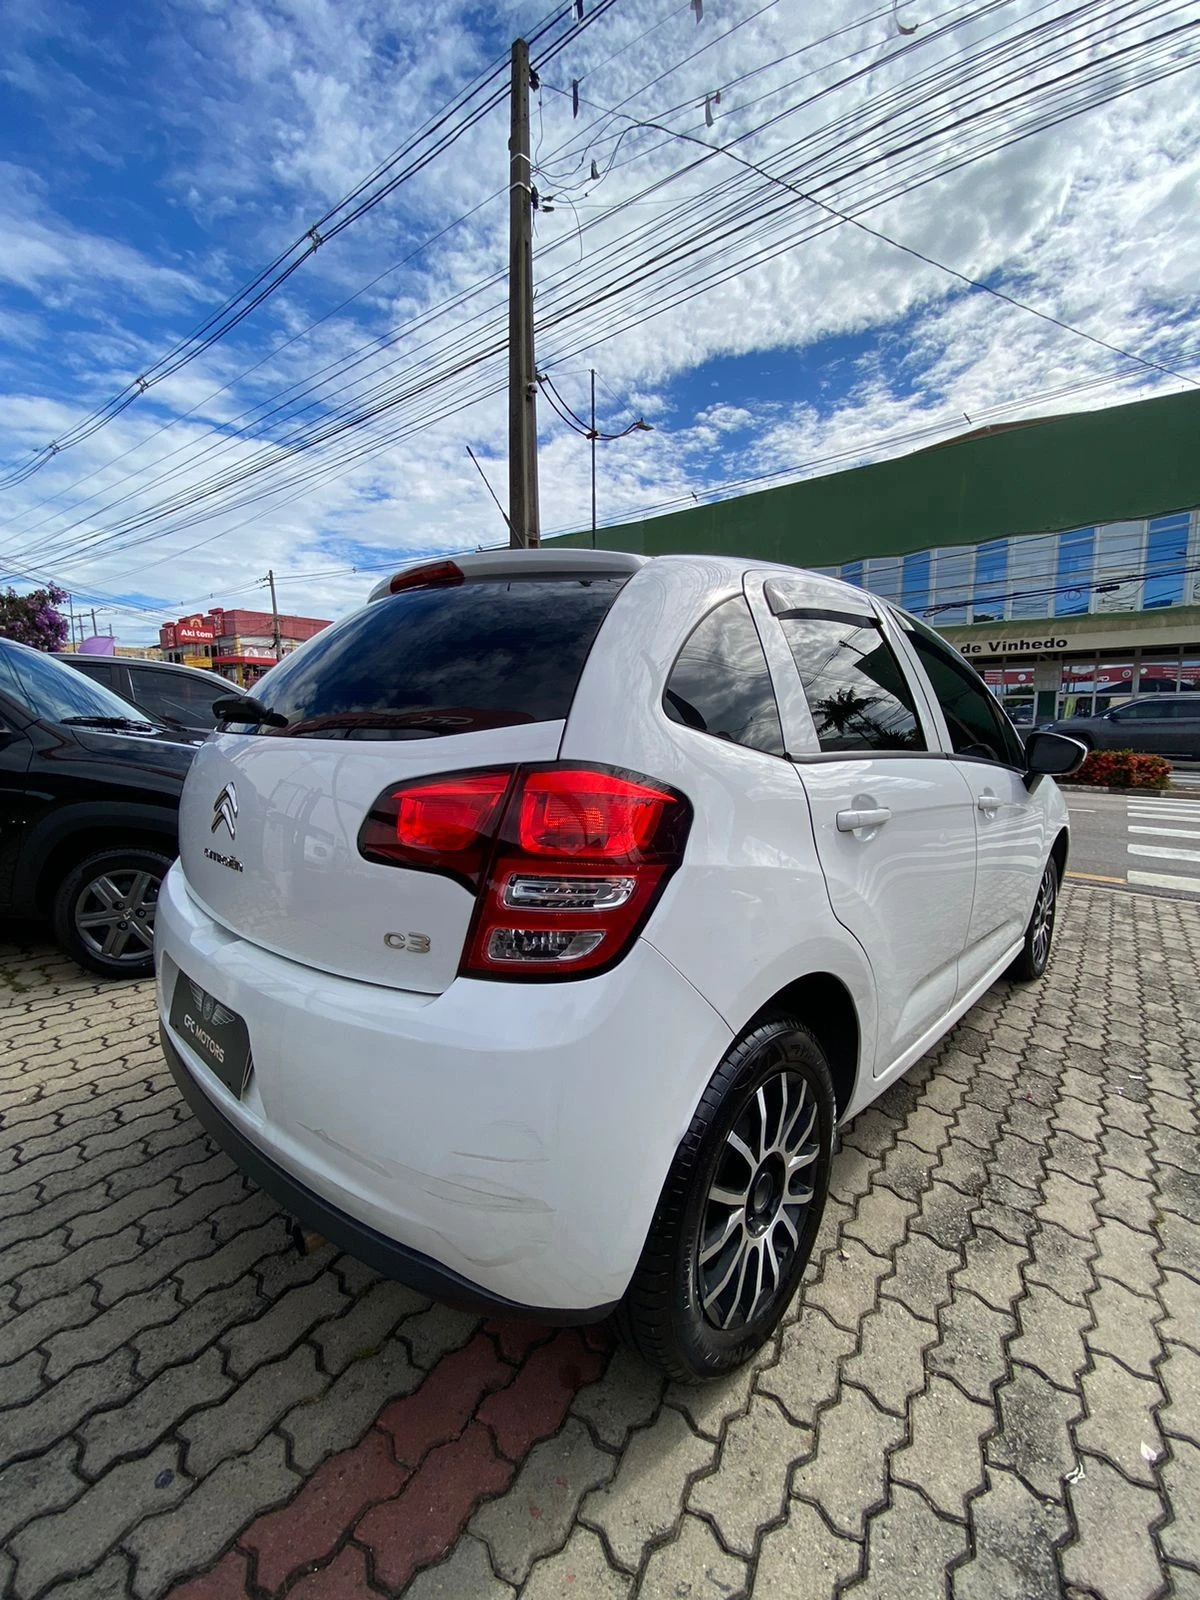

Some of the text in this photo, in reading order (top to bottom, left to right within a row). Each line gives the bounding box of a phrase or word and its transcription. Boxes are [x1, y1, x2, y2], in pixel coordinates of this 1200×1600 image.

[181, 629, 195, 637] Aki
[960, 637, 1068, 654] de Vinhedo
[384, 931, 431, 954] C3
[195, 1025, 225, 1063] MOTORS
